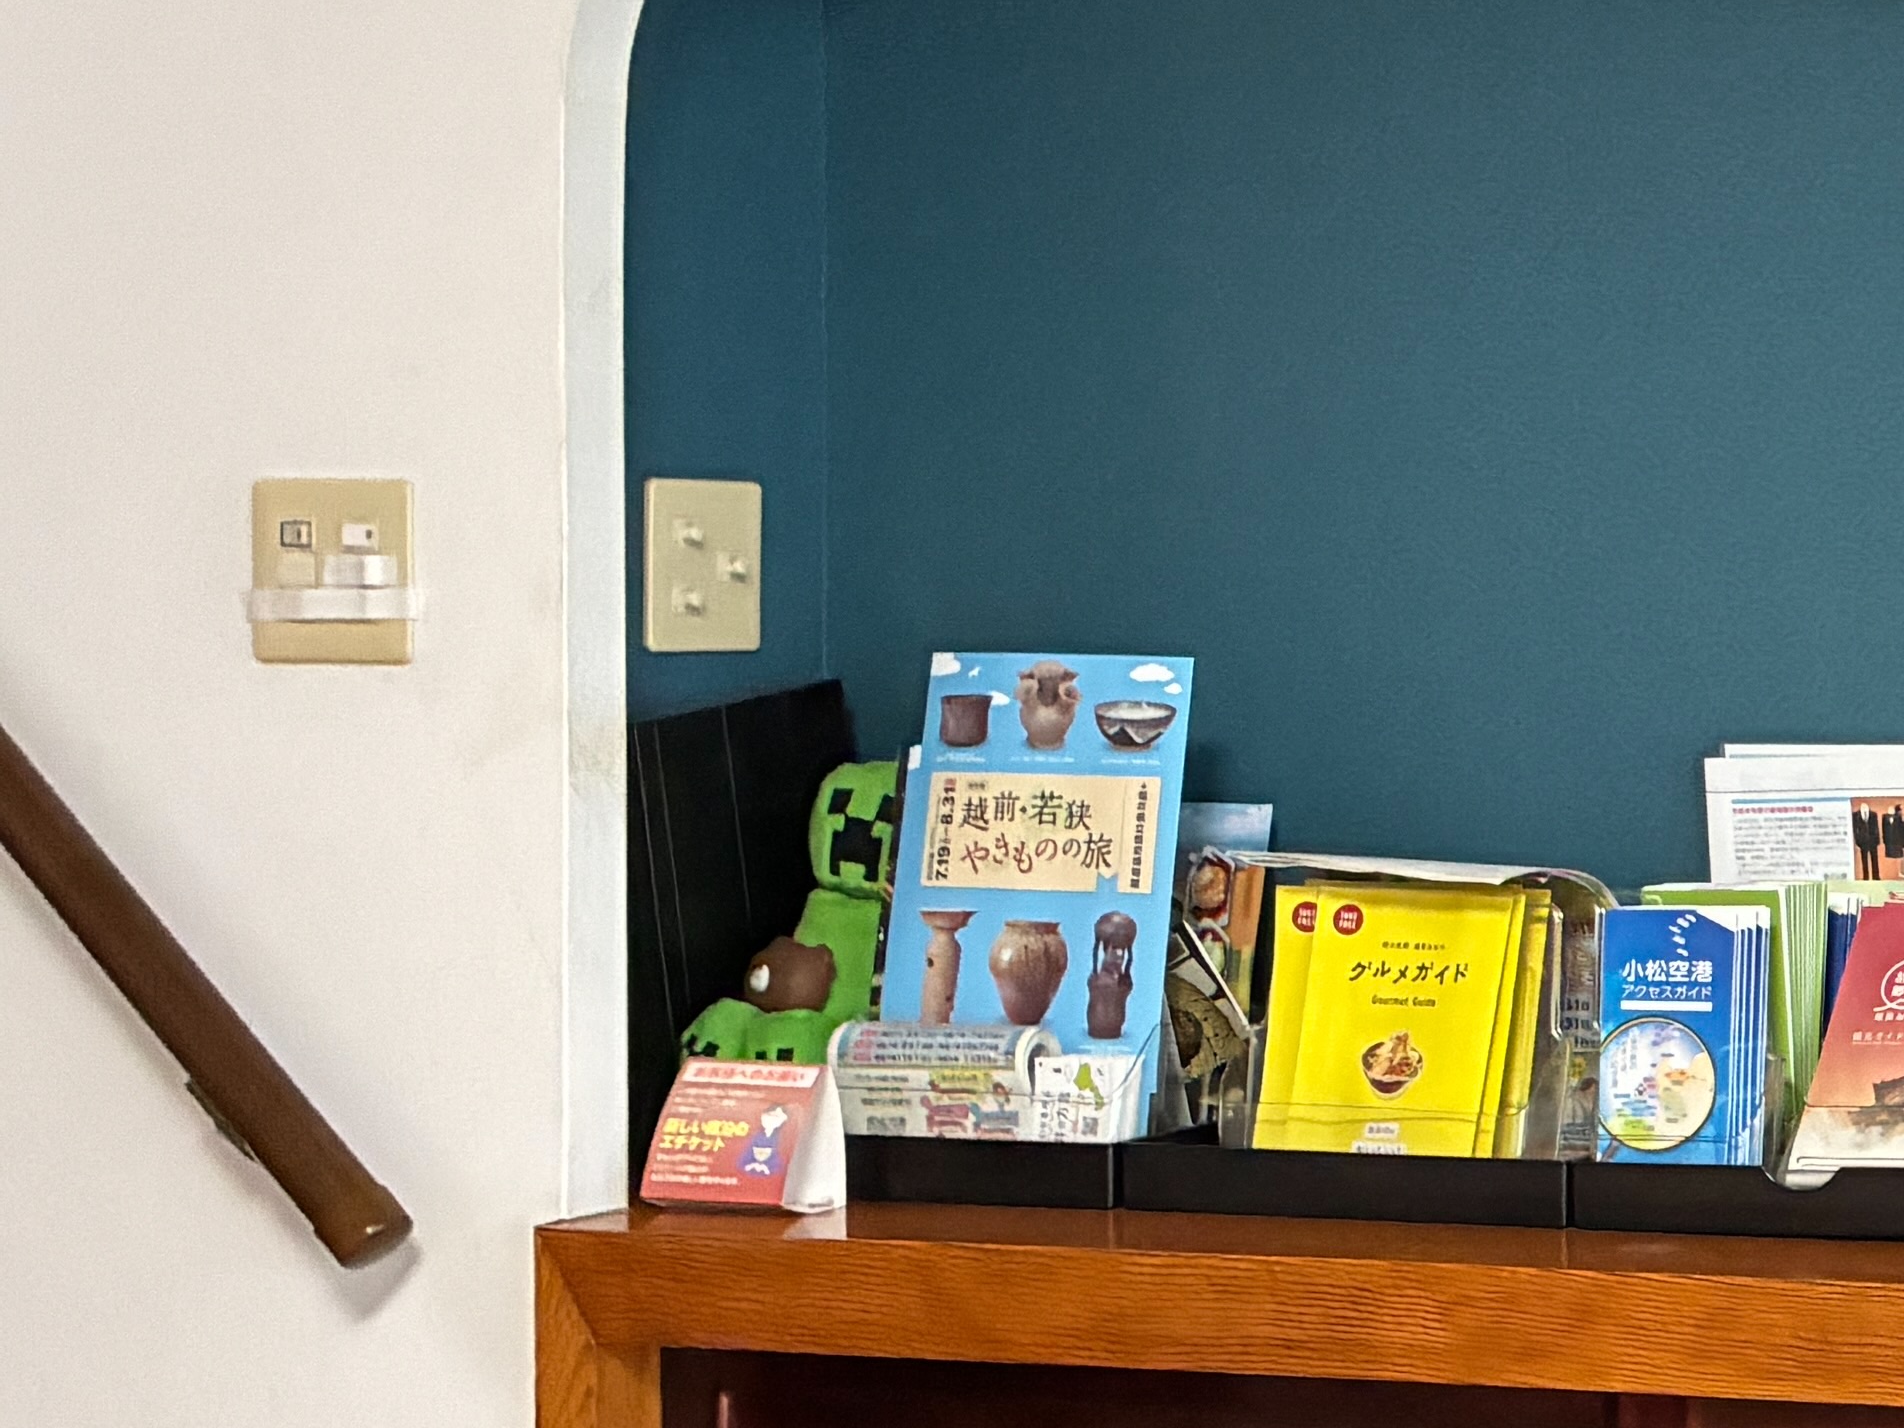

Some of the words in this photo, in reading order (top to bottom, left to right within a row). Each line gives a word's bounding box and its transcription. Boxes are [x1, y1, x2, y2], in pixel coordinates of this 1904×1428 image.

[960, 832, 1113, 875] やきものの旅
[1349, 960, 1468, 985] グルメガイド
[1621, 958, 1713, 983] 小松空港
[1621, 984, 1712, 999] アクセスガイド
